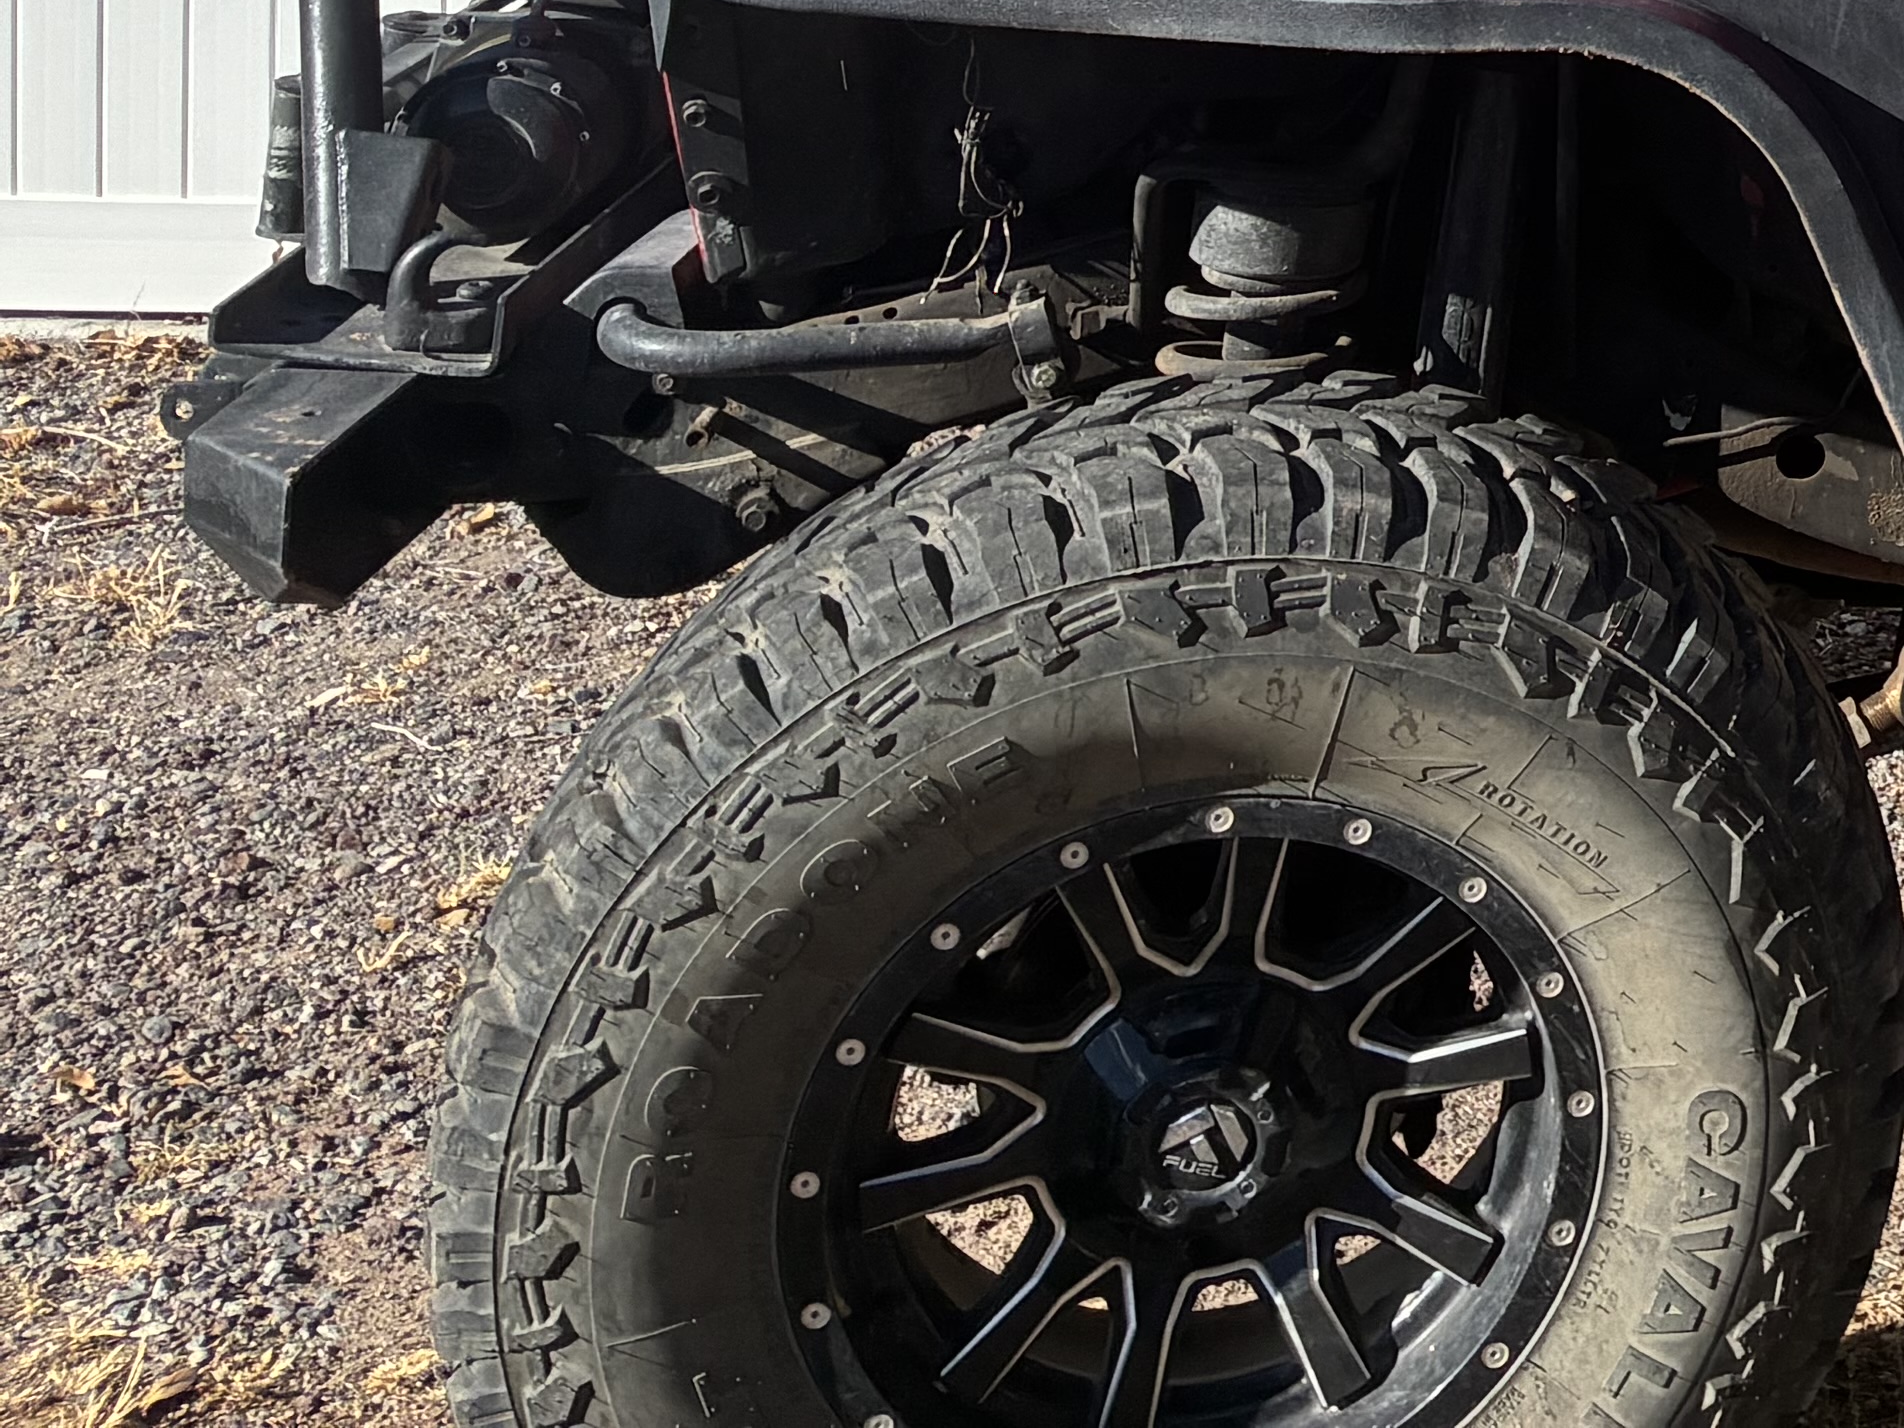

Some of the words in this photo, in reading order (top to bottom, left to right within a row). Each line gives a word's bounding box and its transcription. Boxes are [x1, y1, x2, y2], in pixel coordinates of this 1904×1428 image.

[1477, 781, 1610, 869] ROTATION
[618, 734, 1026, 1222] ROADONE
[1162, 1154, 1227, 1179] FUEL
